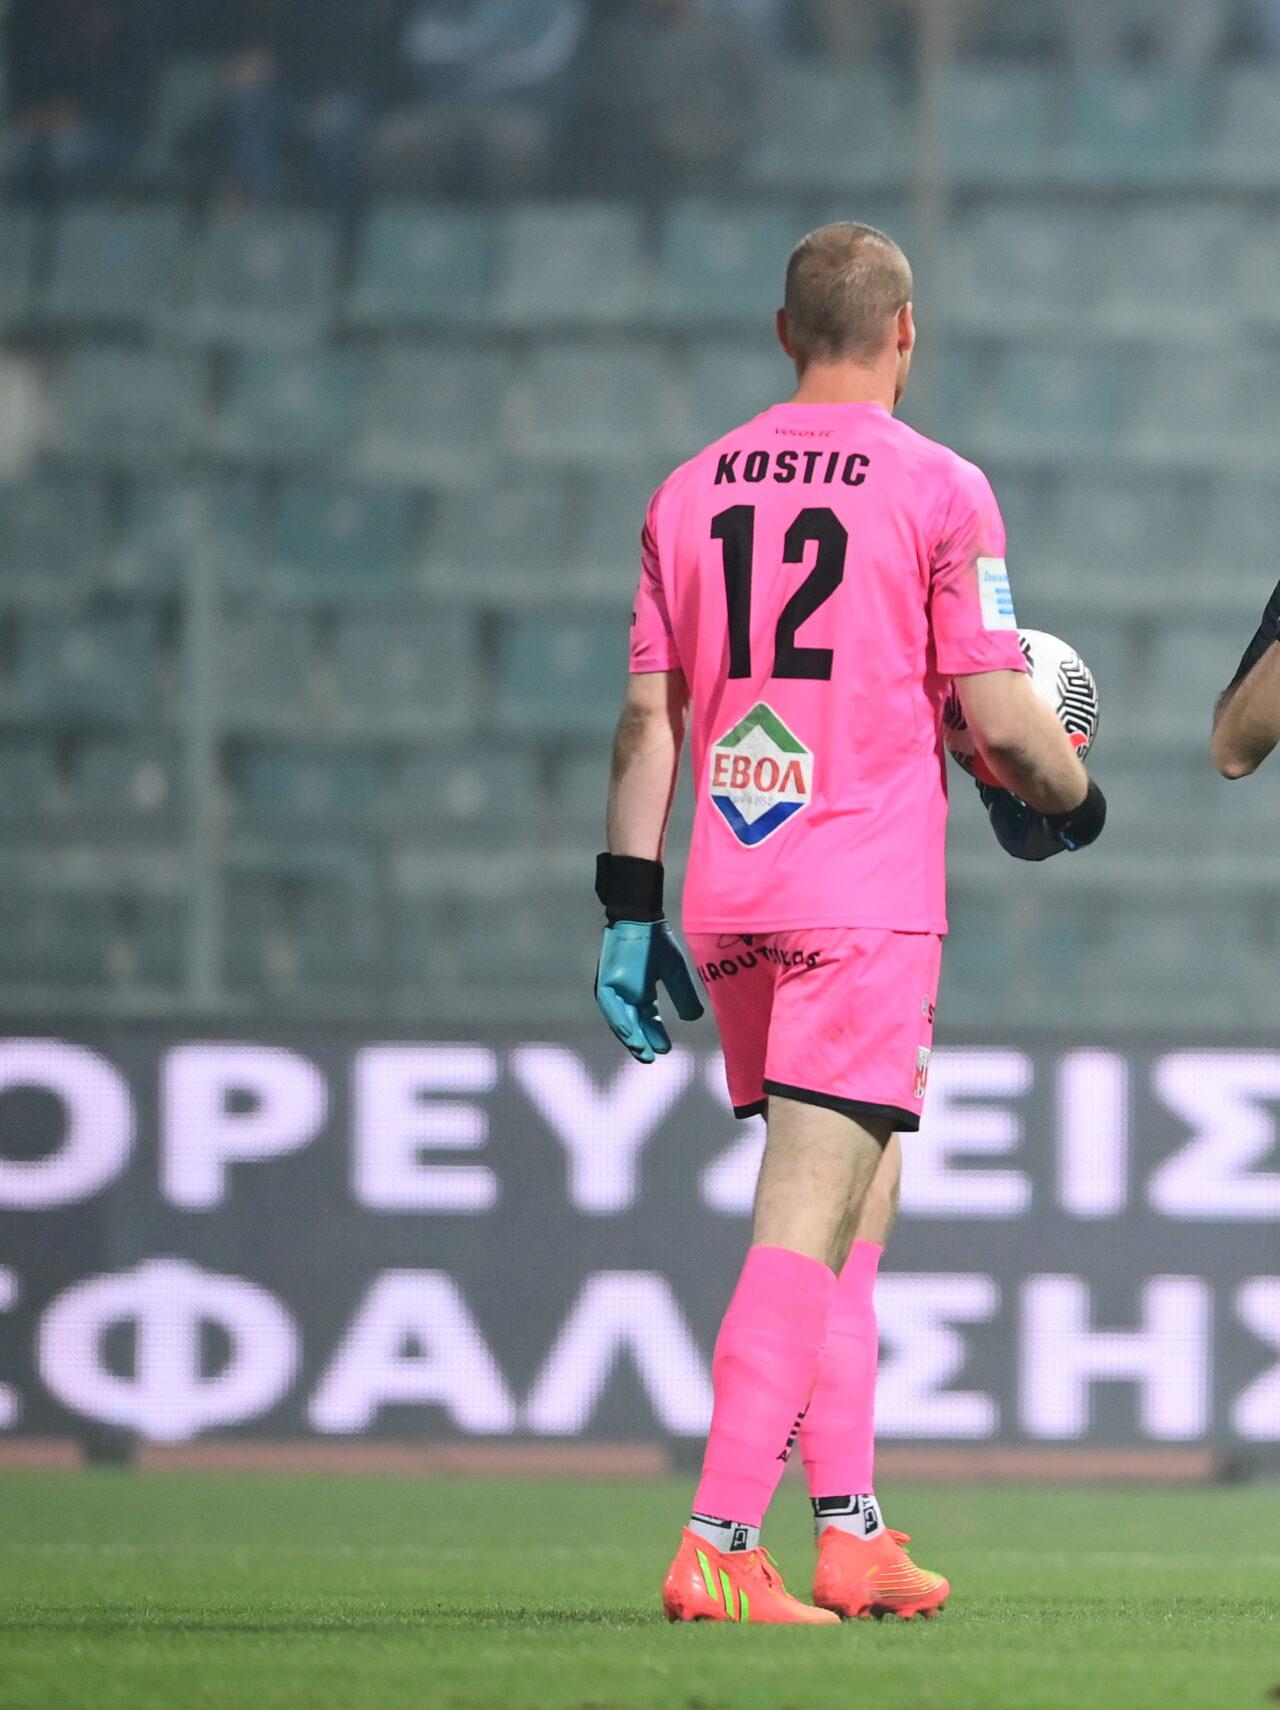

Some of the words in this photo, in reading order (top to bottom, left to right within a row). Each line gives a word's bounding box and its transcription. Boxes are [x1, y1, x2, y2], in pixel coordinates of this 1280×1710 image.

[714, 451, 870, 486] KOSTIC
[711, 505, 848, 680] 12
[712, 753, 806, 794] ΕΒΟΛ
